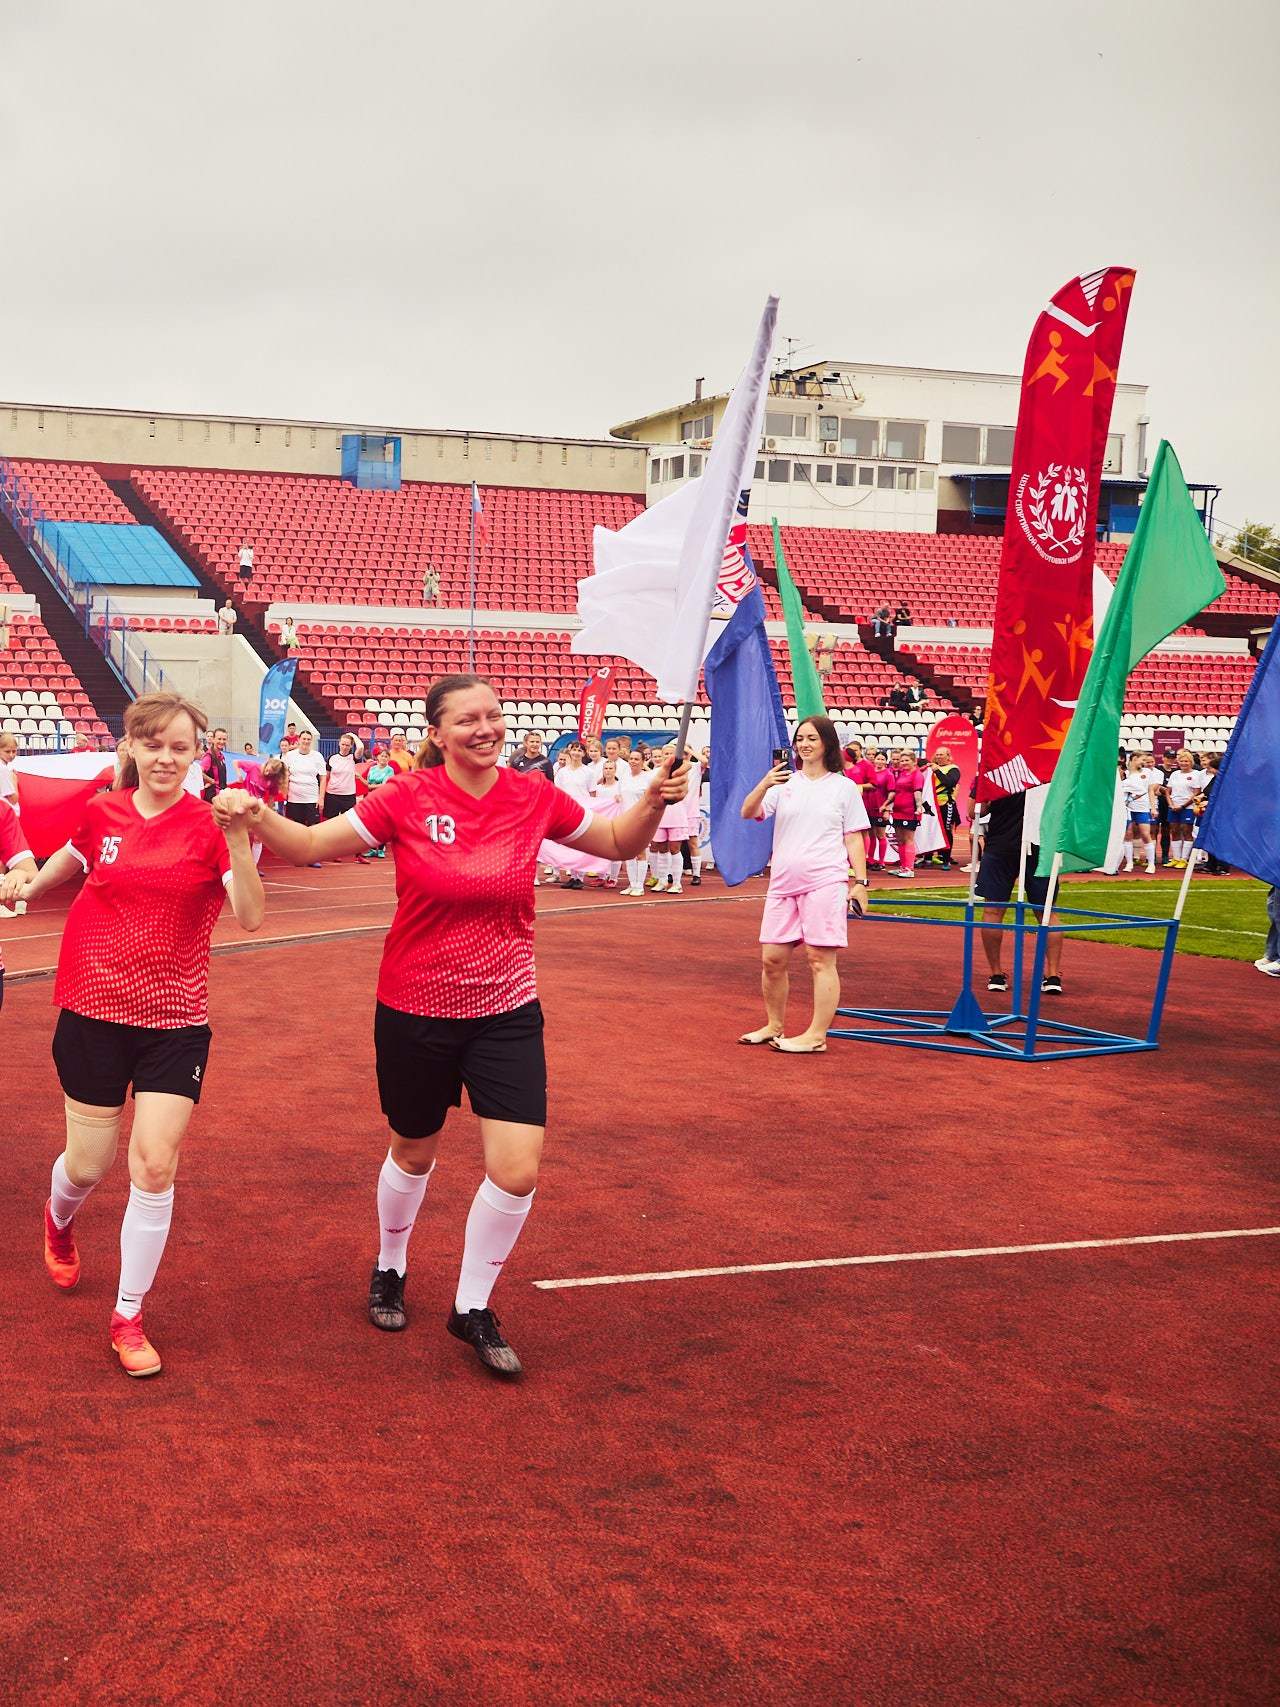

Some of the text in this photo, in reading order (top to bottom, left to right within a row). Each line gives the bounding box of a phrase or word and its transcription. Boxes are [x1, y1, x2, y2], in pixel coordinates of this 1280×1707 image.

[1016, 473, 1031, 499] ЦЕНТР
[1015, 499, 1038, 547] СПОРТИВНОЙ
[581, 694, 597, 739] ОСНОВА
[425, 814, 456, 845] 13
